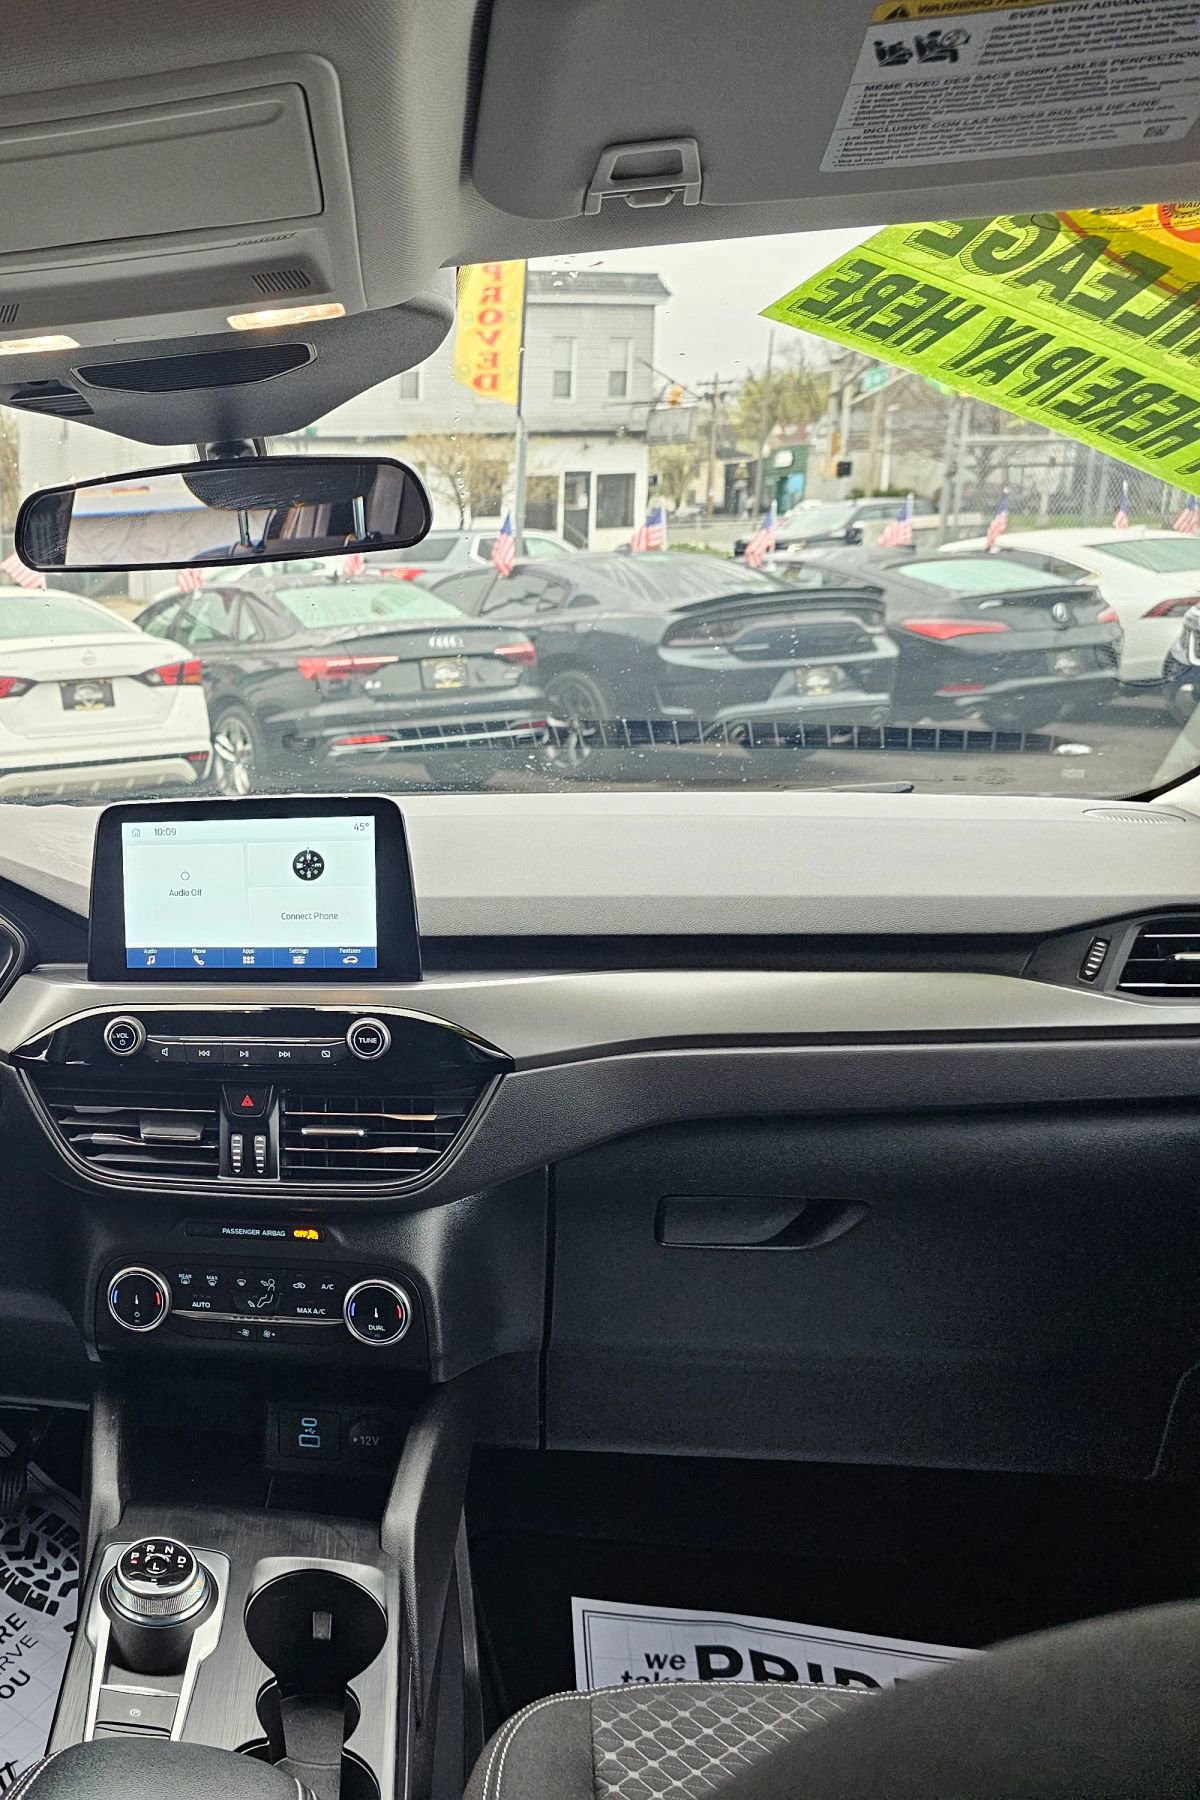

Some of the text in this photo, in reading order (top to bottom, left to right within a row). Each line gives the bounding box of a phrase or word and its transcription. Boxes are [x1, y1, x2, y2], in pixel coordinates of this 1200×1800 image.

[353, 822, 370, 832] 45°
[154, 827, 177, 837] 10:09
[168, 888, 202, 897] Audio Off
[280, 911, 339, 921] Connect Phone
[115, 1032, 129, 1040] VOL
[358, 1036, 378, 1045] TUNE
[221, 1227, 286, 1237] PASSENGER AIRBAG
[321, 1282, 335, 1291] A/C
[191, 1301, 211, 1309] AUTO
[296, 1307, 327, 1316] MAX A/C
[368, 1324, 386, 1332] DUAL
[360, 1435, 380, 1446] 12V
[146, 1544, 156, 1552] R
[164, 1545, 174, 1554] N
[177, 1556, 187, 1564] D
[152, 1562, 160, 1570] L
[644, 1652, 687, 1671] we
